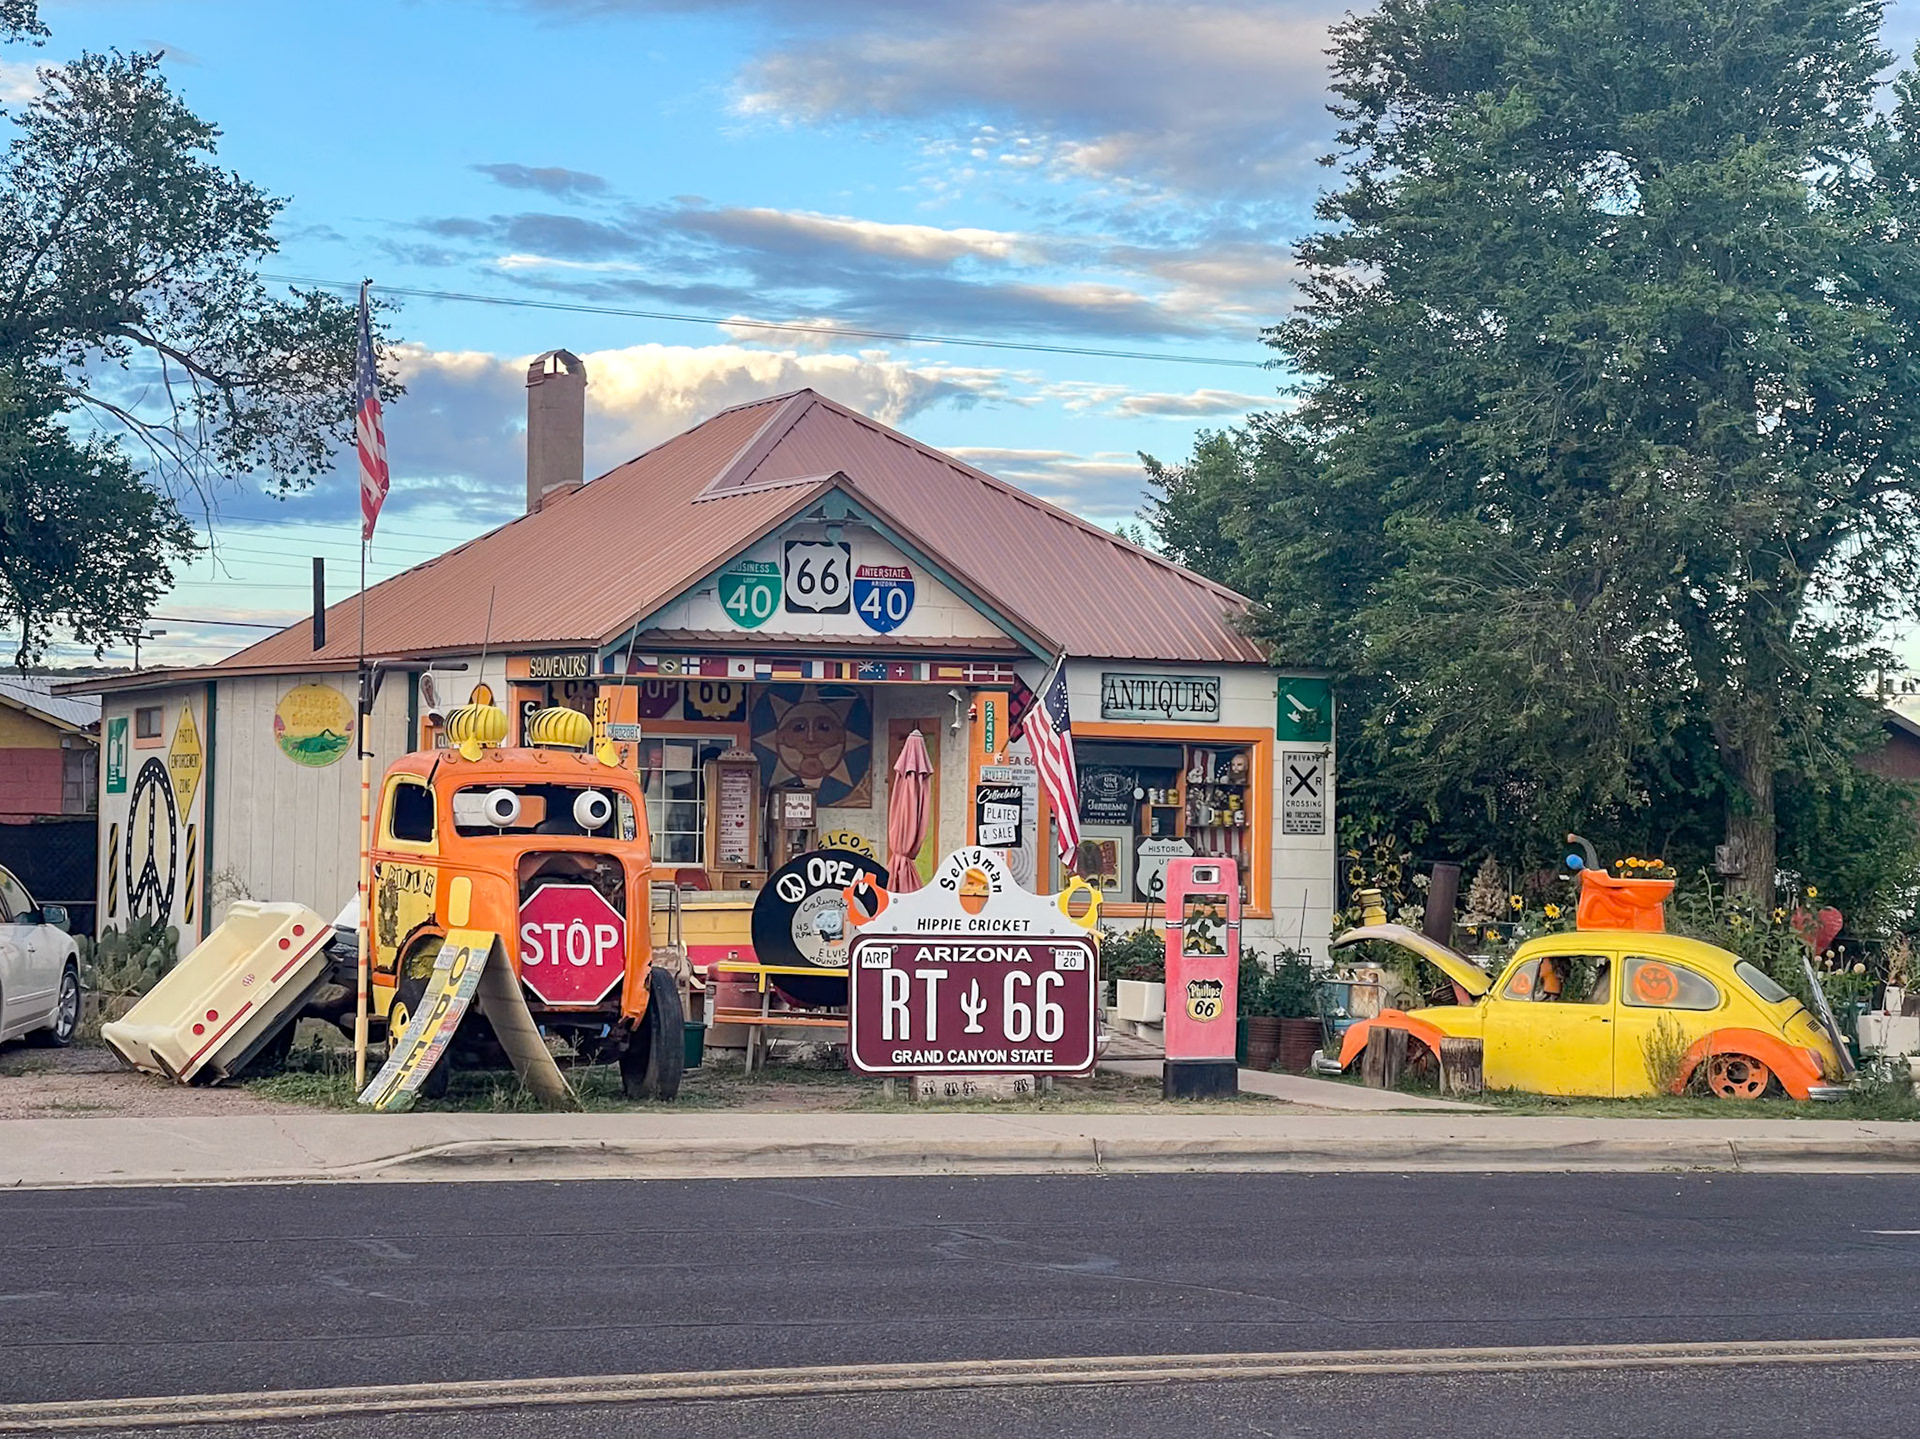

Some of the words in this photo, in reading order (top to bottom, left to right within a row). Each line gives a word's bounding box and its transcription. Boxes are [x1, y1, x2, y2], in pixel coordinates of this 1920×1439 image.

[735, 562, 770, 573] USINESS
[861, 567, 906, 578] INTERSTATE
[796, 557, 840, 595] 66
[726, 585, 772, 618] 40
[860, 588, 907, 620] 40
[530, 655, 587, 678] SOUVENIRS
[1105, 679, 1217, 719] ANTIQUES
[985, 701, 994, 753] 22435
[170, 753, 200, 769] ENFORCEMENT
[179, 778, 191, 794] ZONE
[1087, 798, 1128, 811] Tennessee
[1286, 800, 1322, 808] CROSSING
[986, 807, 1018, 821] PLATES
[992, 826, 1013, 840] SALE
[1148, 845, 1184, 853] HISTORIC
[939, 850, 1002, 893] Seligman
[796, 923, 809, 932] 45
[917, 918, 962, 931] HIPPIE
[968, 918, 1031, 932] CRICKET
[795, 931, 812, 939] RPM
[818, 948, 848, 958] ELVIS
[864, 951, 889, 966] ARP
[914, 947, 1033, 963] ARIZONA
[809, 956, 839, 966] HOUND
[1063, 957, 1077, 967] 20
[1190, 984, 1221, 999] Phillips
[881, 968, 949, 1042] RT
[1003, 970, 1065, 1043] 66
[1194, 1000, 1216, 1018] 66
[374, 946, 470, 1106] OPEN
[891, 1049, 944, 1064] GRAND
[947, 1049, 1009, 1064] CANYON
[1010, 1050, 1054, 1064] STATE
